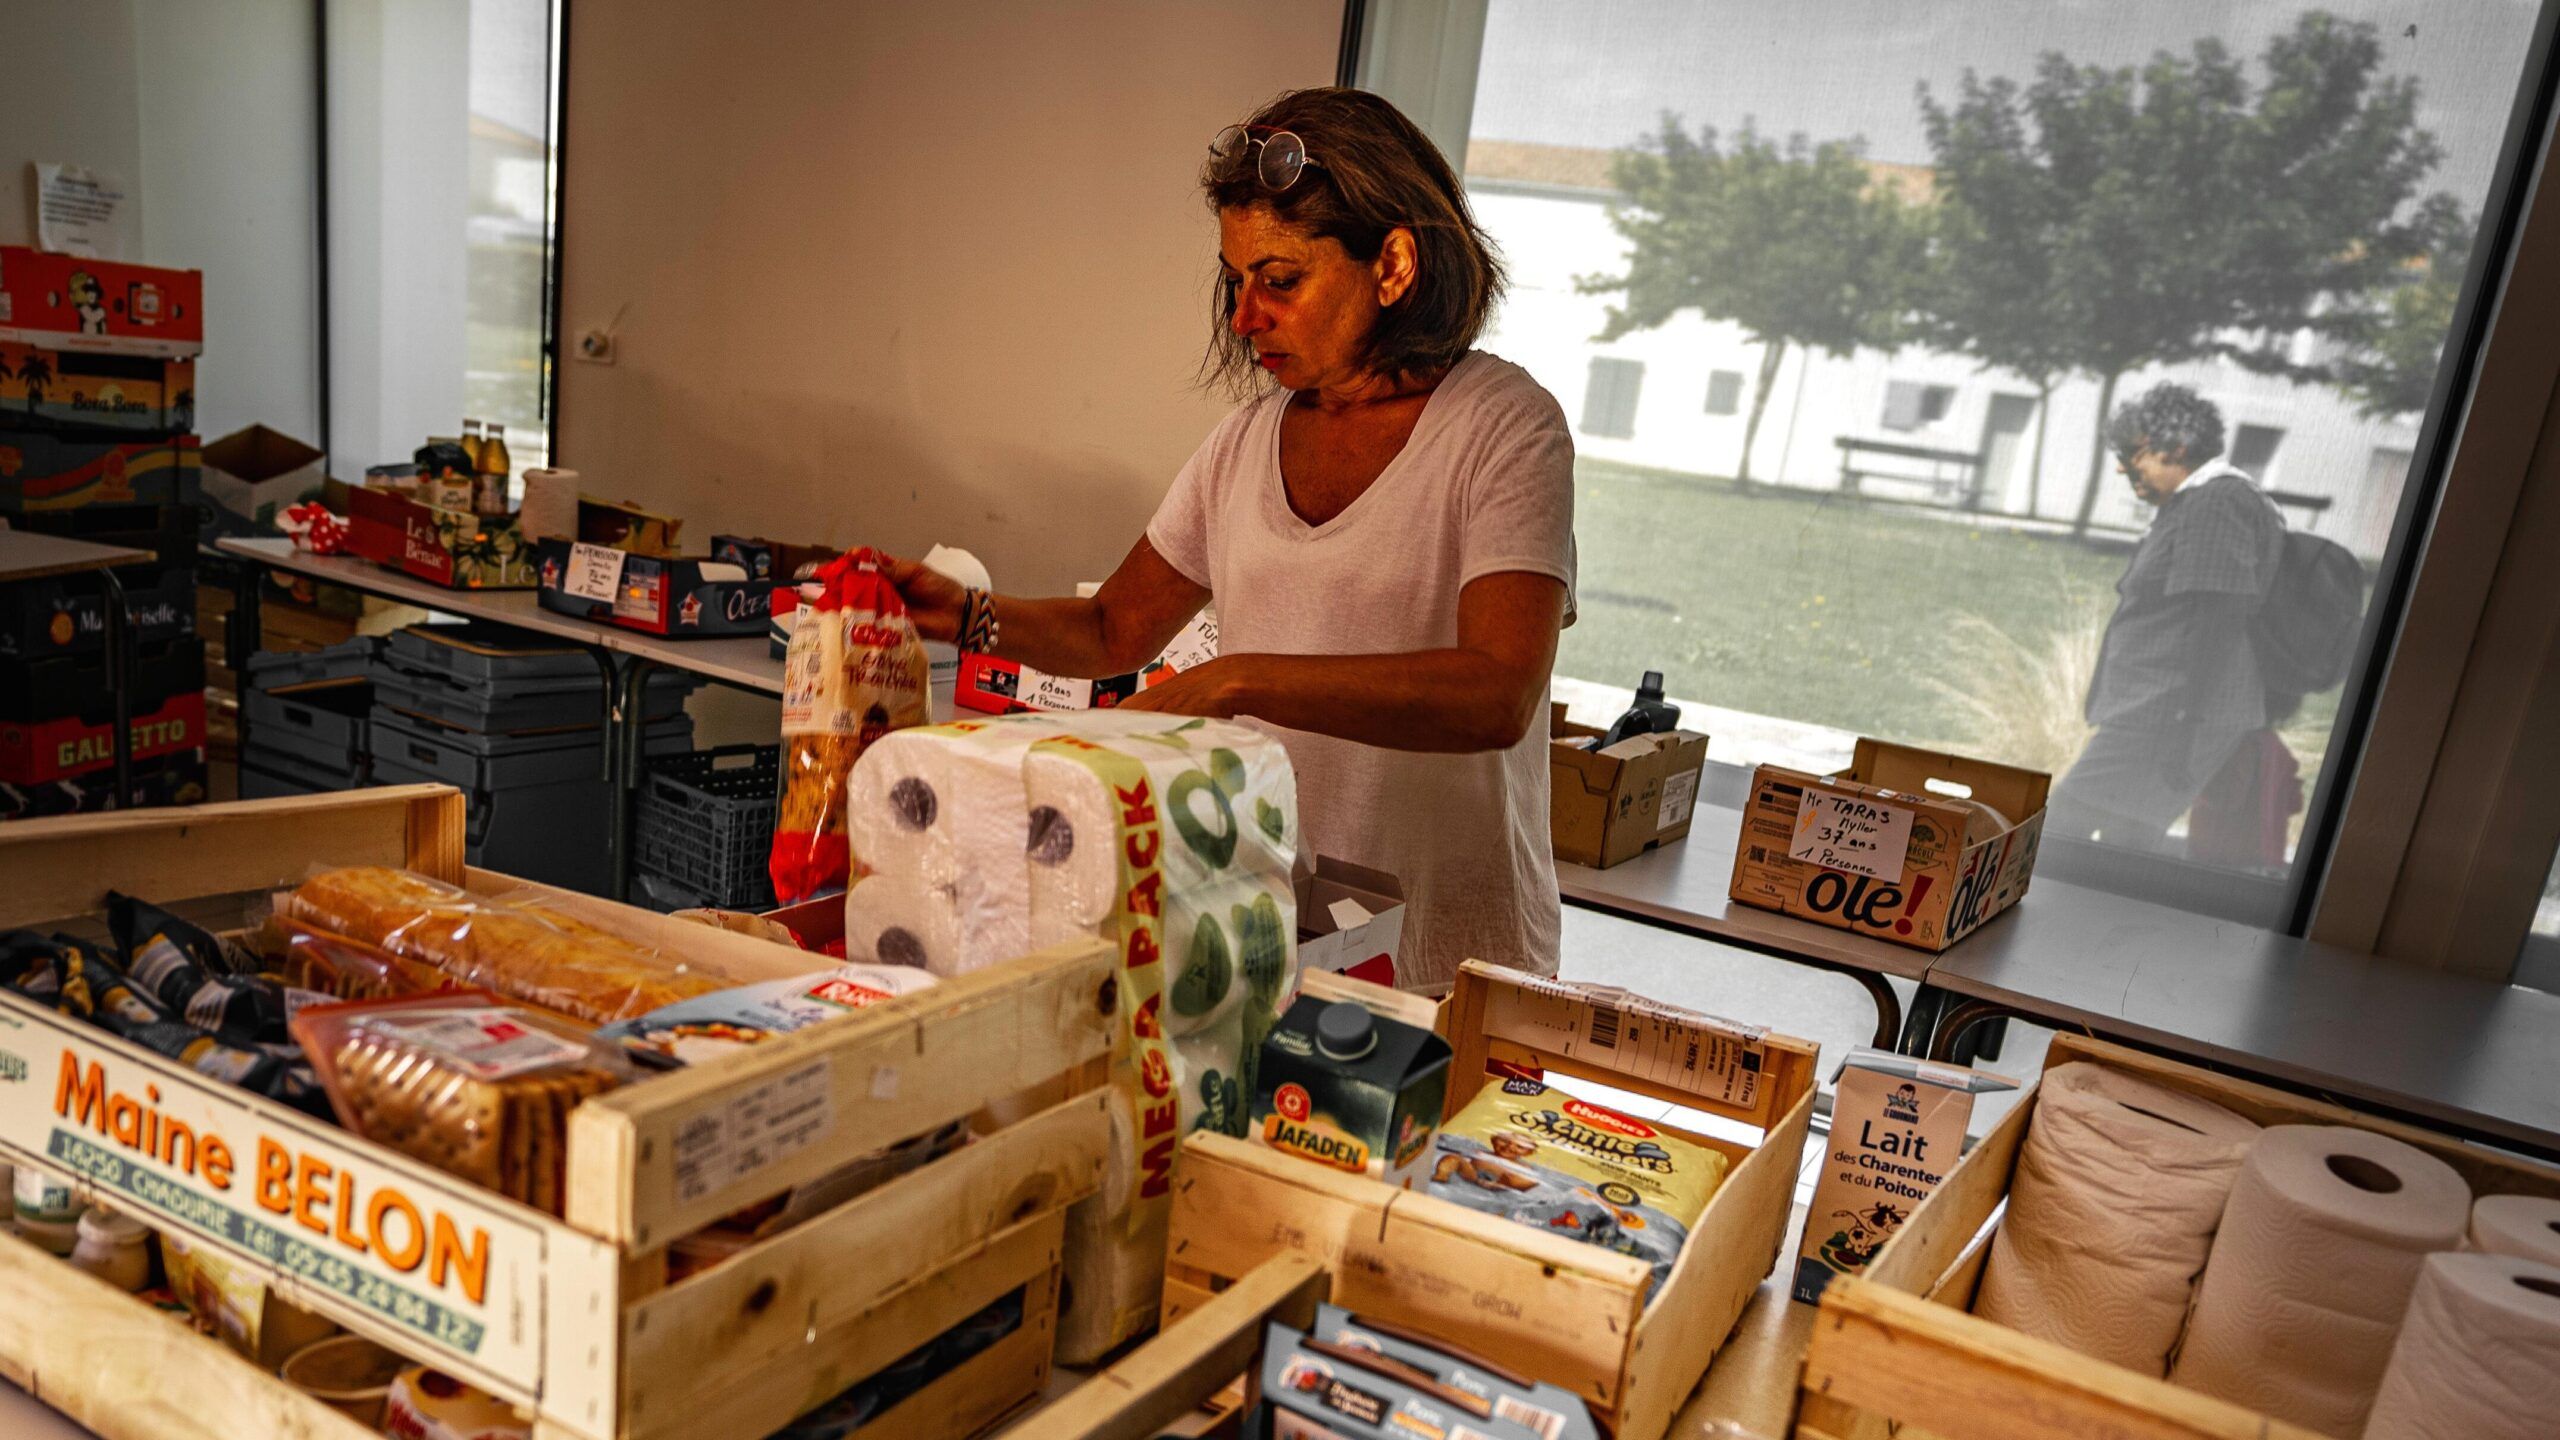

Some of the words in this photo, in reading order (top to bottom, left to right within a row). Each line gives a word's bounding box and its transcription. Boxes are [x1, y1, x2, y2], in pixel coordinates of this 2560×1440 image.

[72, 390, 109, 412] Bora
[113, 393, 149, 413] Bora
[1040, 681, 1052, 693] 69
[1054, 687, 1071, 698] ans
[58, 718, 187, 768] GALETTO
[1830, 796, 1891, 824] TARAS
[1817, 827, 1845, 845] 37
[1849, 837, 1877, 851] ans
[1113, 776, 1161, 969] PACK
[1818, 848, 1877, 876] Personne
[1132, 990, 1178, 1200] MEGA
[53, 1048, 235, 1191] Maine
[1860, 1119, 1929, 1162] Lait
[1271, 1118, 1361, 1166] JAFADEN
[1509, 1110, 1673, 1174] Swimmers
[1834, 1150, 1857, 1166] des
[1859, 1154, 1943, 1186] Charentes
[1840, 1170, 1853, 1183] et
[1854, 1174, 1872, 1188] du
[1874, 1176, 1928, 1201] Poitou
[254, 1134, 491, 1309] BELON
